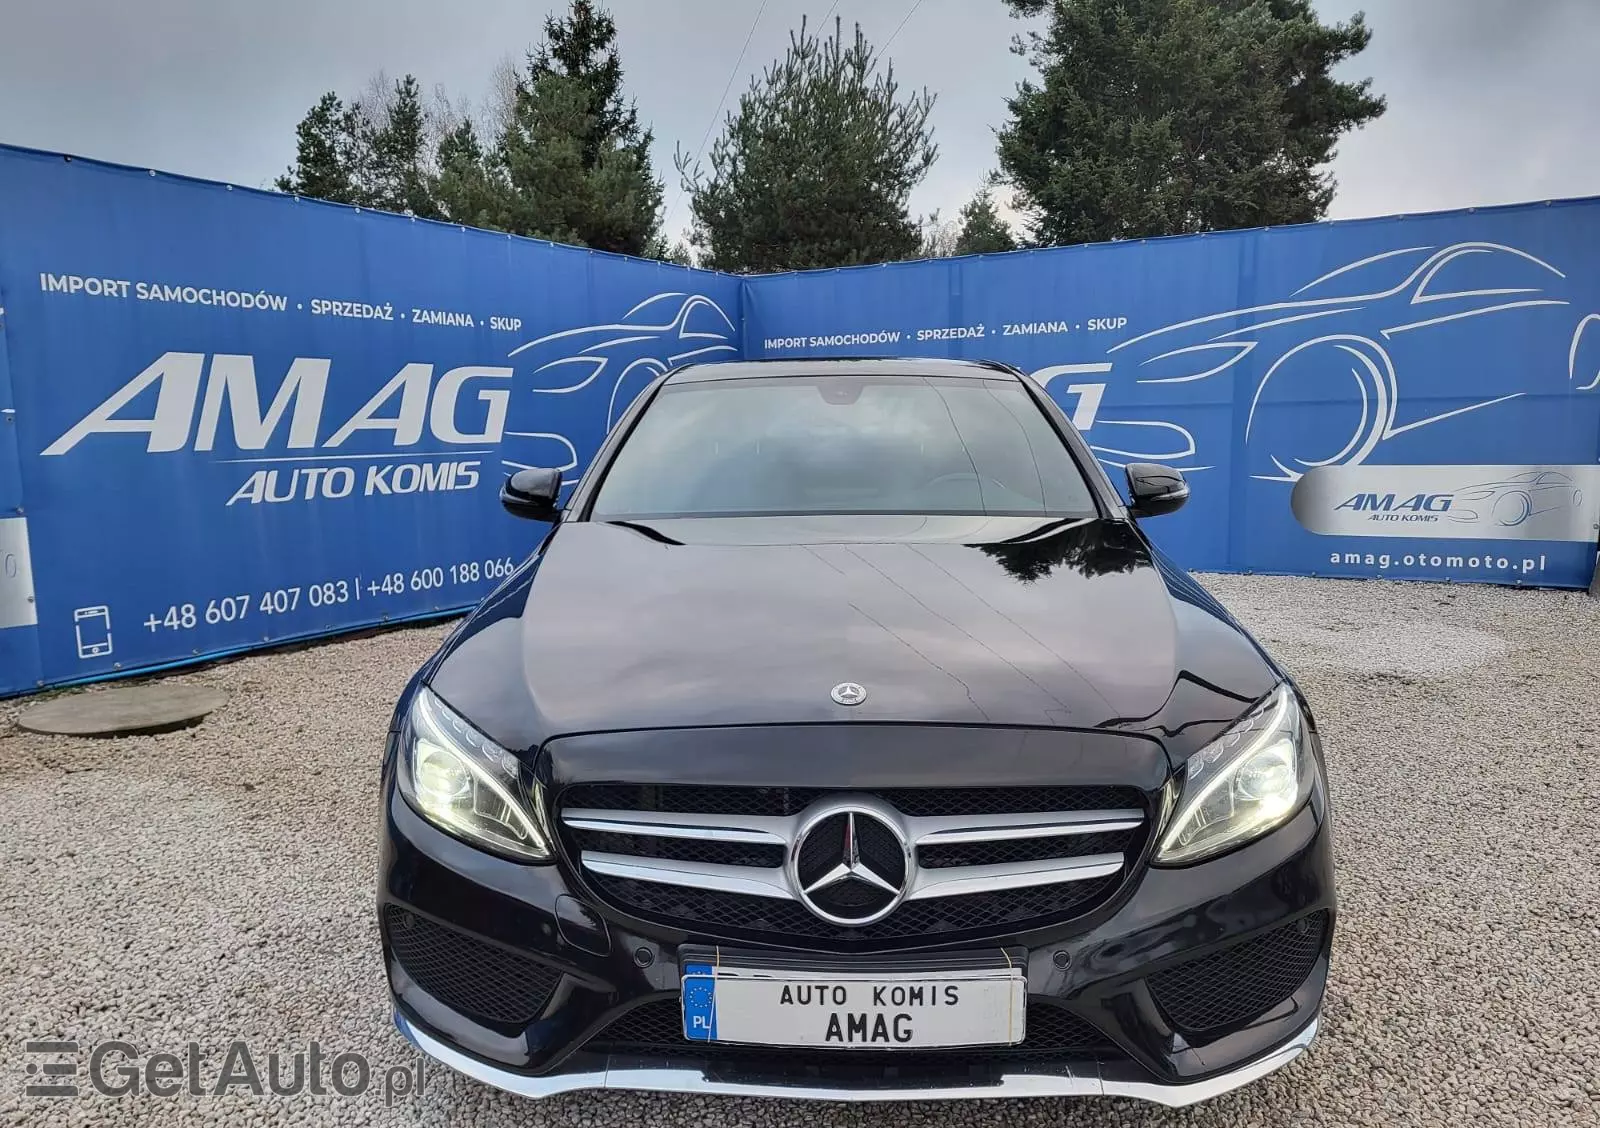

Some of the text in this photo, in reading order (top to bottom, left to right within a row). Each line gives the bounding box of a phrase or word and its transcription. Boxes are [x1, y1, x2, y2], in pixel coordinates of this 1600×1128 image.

[39, 272, 522, 332] IMPORT SAMOCHODÓW SPRZEDAŻ ZAMIANA SKUP
[764, 317, 1127, 350] IMPORT SAMOCHODÓW SPRZEDAŻ ZAMIANA SKUP
[39, 350, 514, 456] AMAG
[225, 460, 481, 506] AUTO KOMIS
[1333, 493, 1454, 512] AMAG
[1367, 513, 1439, 523] AUTO KOMIS
[1330, 552, 1546, 574] amag.otomoto.pl
[143, 557, 514, 633] +48 607 407 083 +48 600 188 066
[780, 985, 959, 1006] AUTO KOMIS
[692, 1016, 711, 1030] PL
[825, 1013, 914, 1043] AMAG
